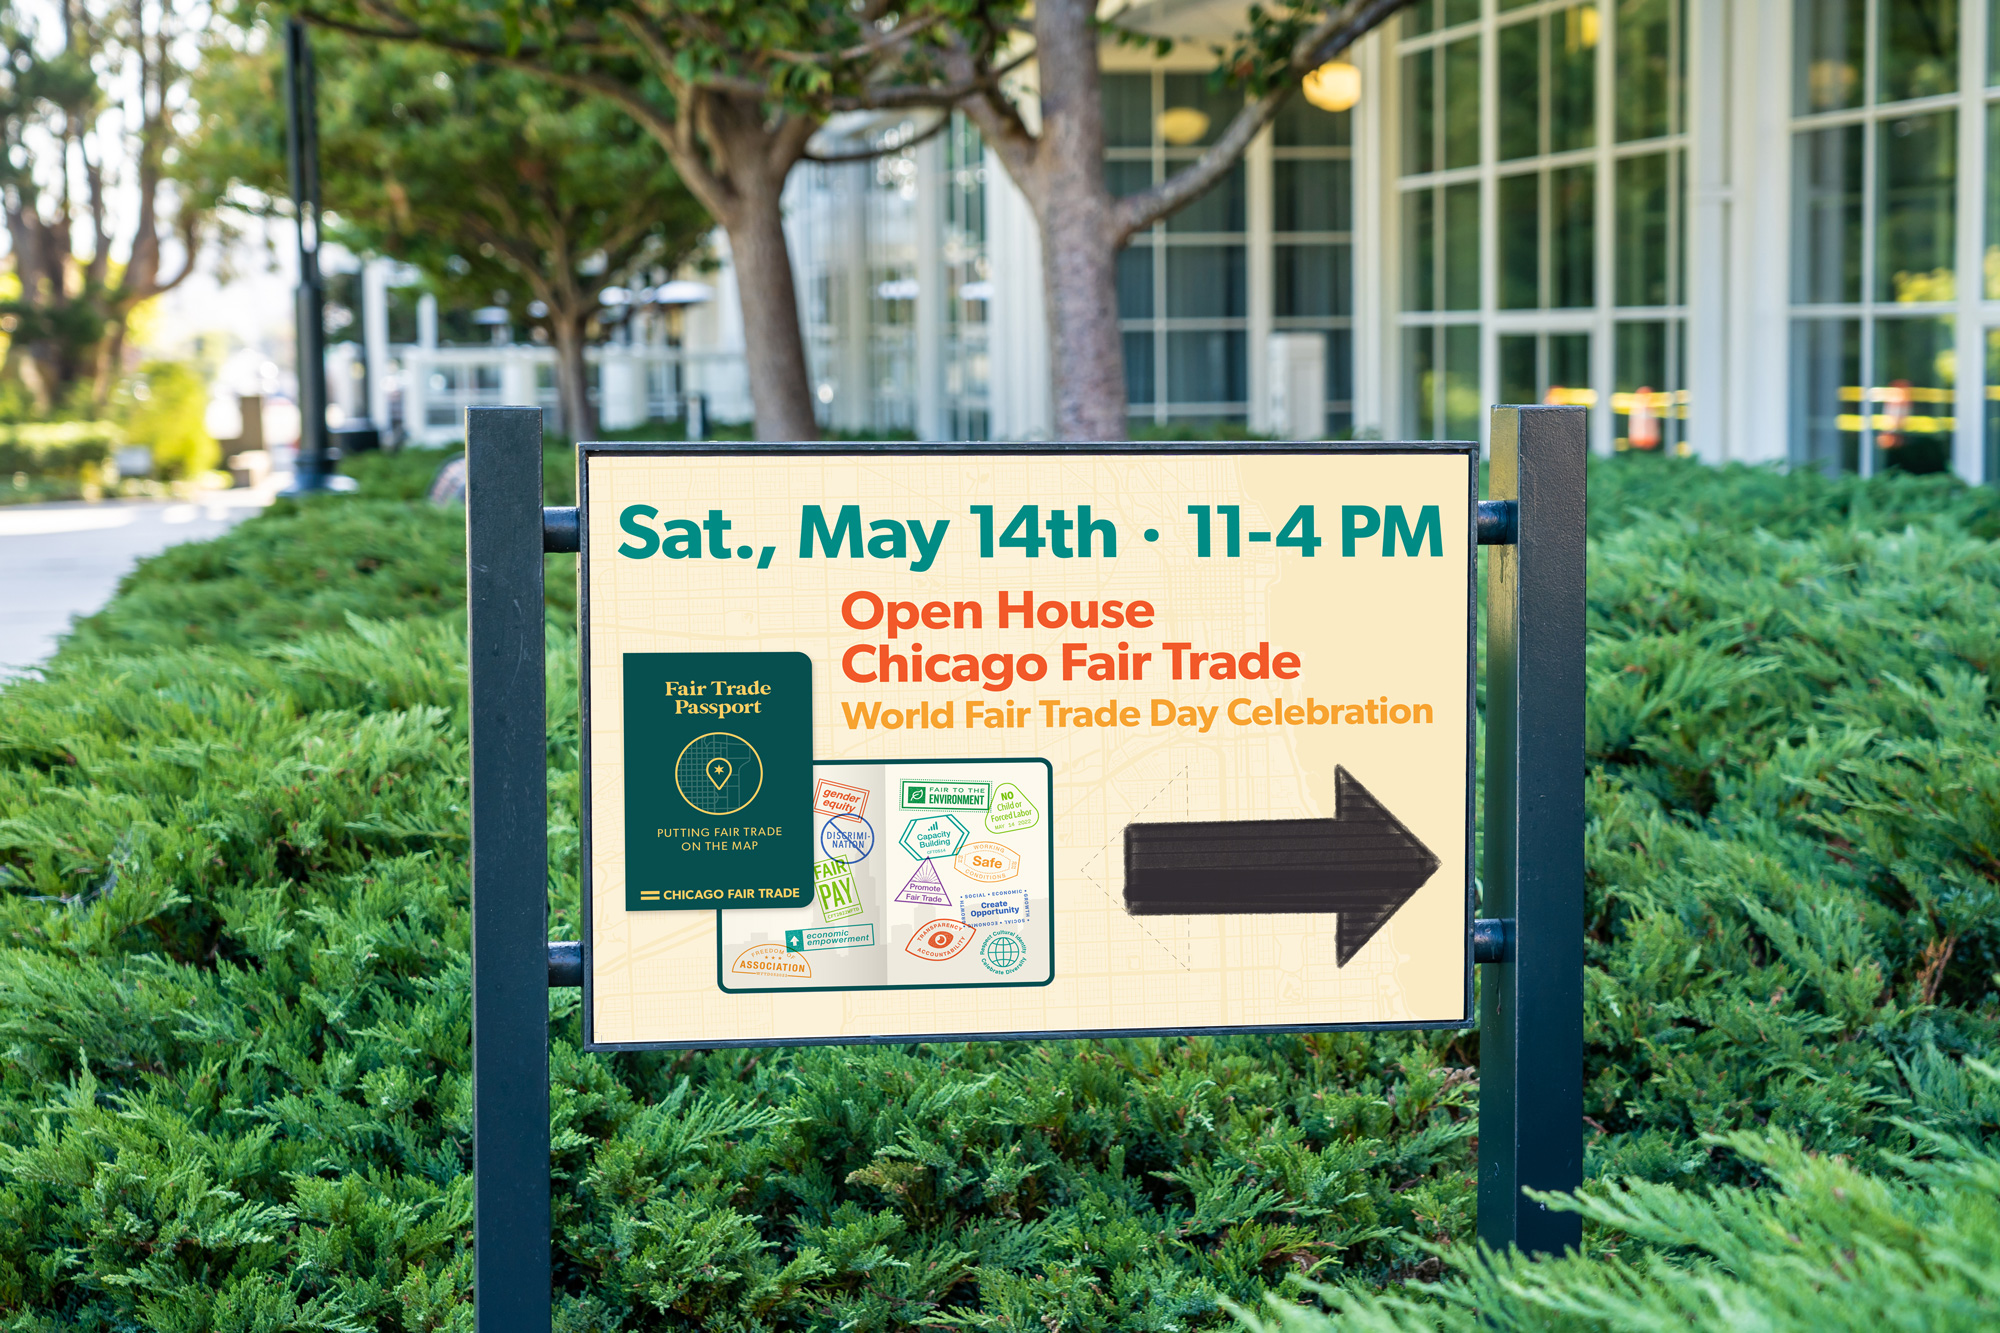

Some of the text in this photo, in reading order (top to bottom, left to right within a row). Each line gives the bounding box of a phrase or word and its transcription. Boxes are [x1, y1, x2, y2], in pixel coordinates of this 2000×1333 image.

[617, 504, 776, 569] Sat.,
[799, 504, 950, 572] May
[970, 505, 1117, 558] 14th
[1188, 504, 1321, 557] 11-4
[1341, 504, 1443, 557] PM
[841, 590, 1155, 639] Open House
[841, 641, 1301, 692] Chicago Fair Trade
[665, 680, 772, 696] Fair Trade
[674, 699, 762, 719] Passport
[841, 696, 1433, 733] World Fair Trade Day Celebration
[822, 789, 861, 803] gender
[929, 794, 984, 805] ENVIRONMENT
[1001, 791, 1014, 801] NO
[822, 799, 856, 814] equity
[997, 802, 1014, 812] Child
[991, 809, 1032, 823] Forced Labor
[657, 826, 783, 838] PUTTING FAIR TRADE
[826, 831, 871, 840] DISCRIMI-
[917, 831, 951, 841] Capacity
[681, 840, 758, 851] ON THE MAP
[832, 840, 865, 849] NATION
[919, 839, 951, 848] Building
[973, 844, 1005, 854] WORKING
[972, 855, 1002, 869] Safe
[814, 858, 847, 880] FAIR
[965, 868, 1007, 880] CONDITIONS
[663, 887, 800, 900] CHICAGO FAIR TRADE
[818, 877, 852, 910] PAY
[909, 883, 941, 892] Promote
[992, 889, 1023, 897] ECONOMIC
[905, 893, 942, 903] Fair Trade
[981, 900, 1008, 909] Create
[970, 906, 1020, 918] Opportunity
[806, 929, 849, 940] economic
[917, 922, 963, 942] TRANSPARENCY
[807, 934, 869, 947] empowerment
[917, 936, 966, 958] ACCOUNTABILITY
[980, 930, 1027, 956] Respect Cultural Identity
[750, 948, 796, 960] FREEDOM OF
[739, 960, 805, 973] ASSOCIATION
[981, 957, 1027, 975] Celebrate Diversity
